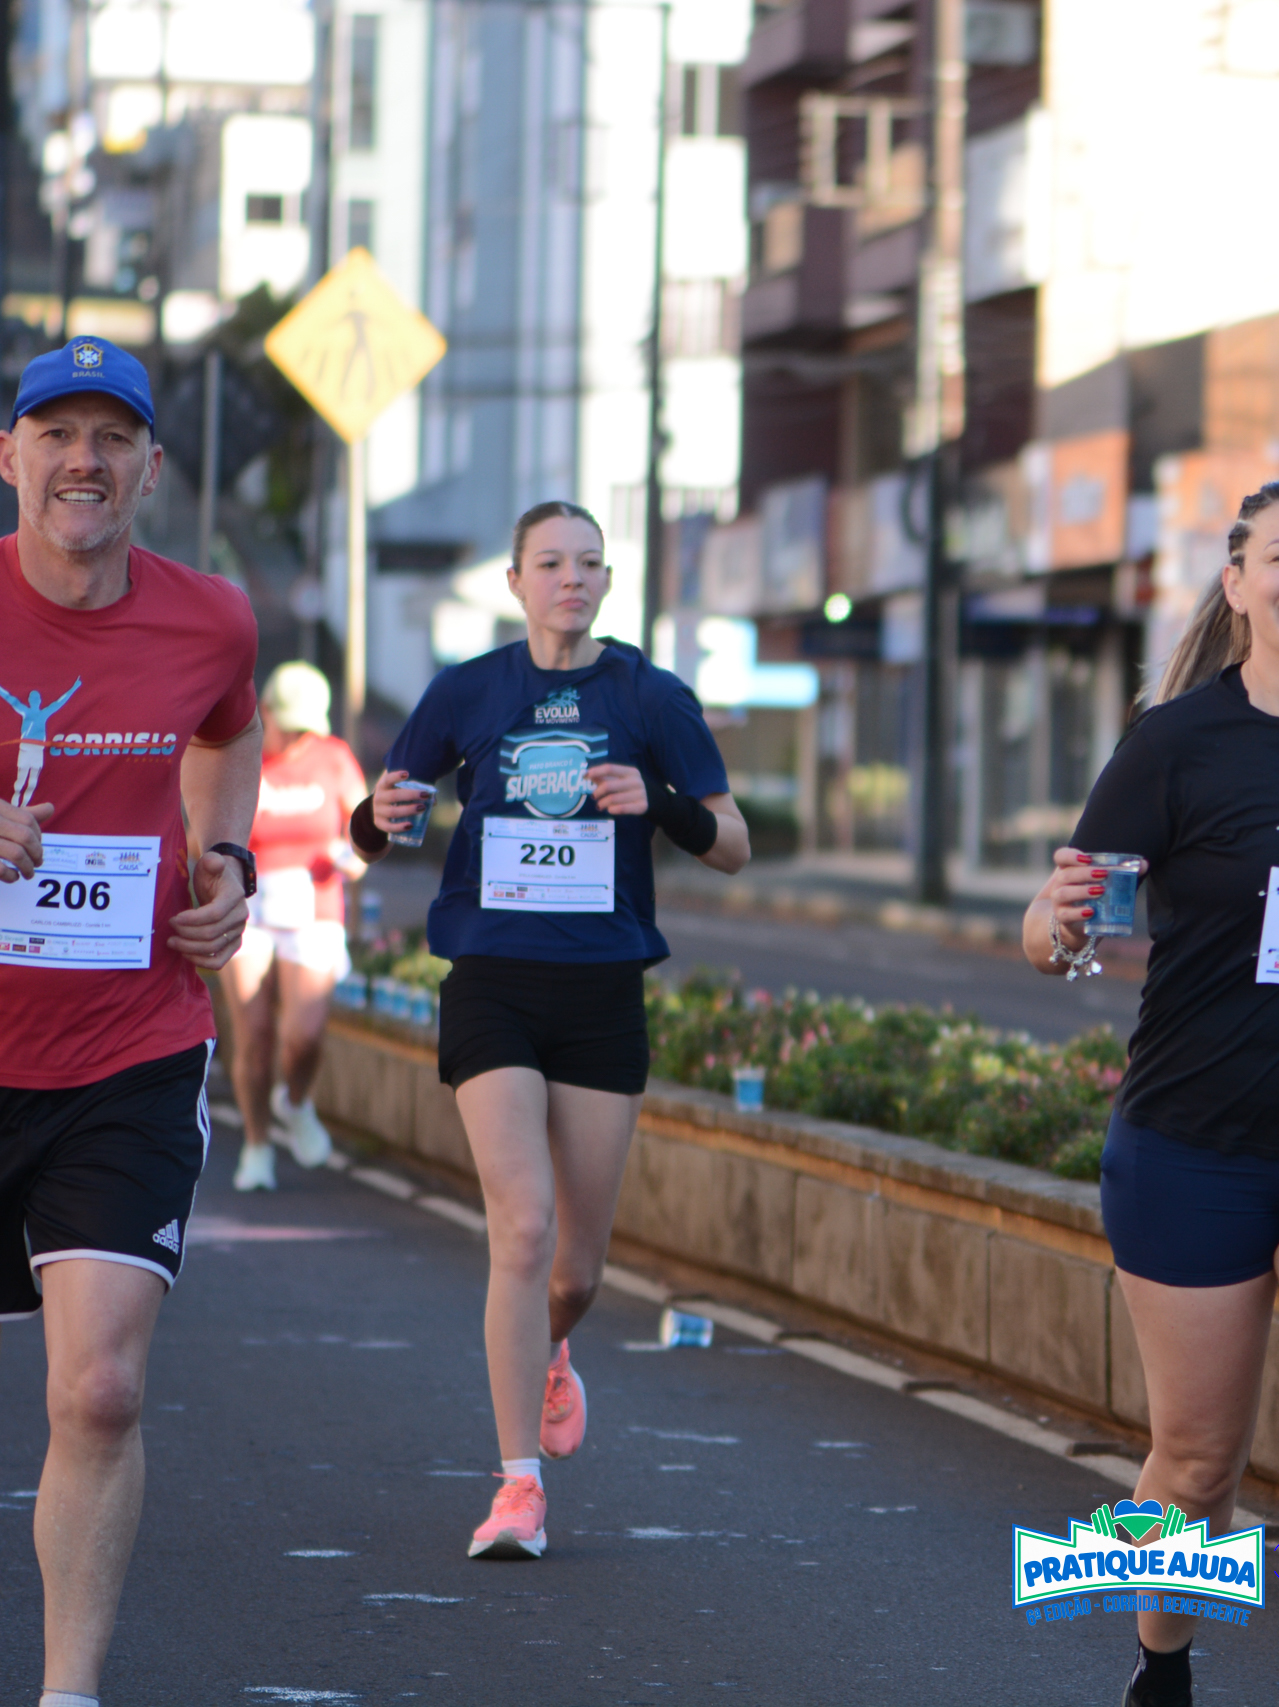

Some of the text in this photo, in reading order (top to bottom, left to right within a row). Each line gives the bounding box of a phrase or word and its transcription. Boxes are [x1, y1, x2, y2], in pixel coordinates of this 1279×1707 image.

[535, 706, 580, 718] EVOLUA
[520, 843, 576, 867] 220
[36, 878, 111, 911] 206
[152, 1233, 179, 1254] adida
